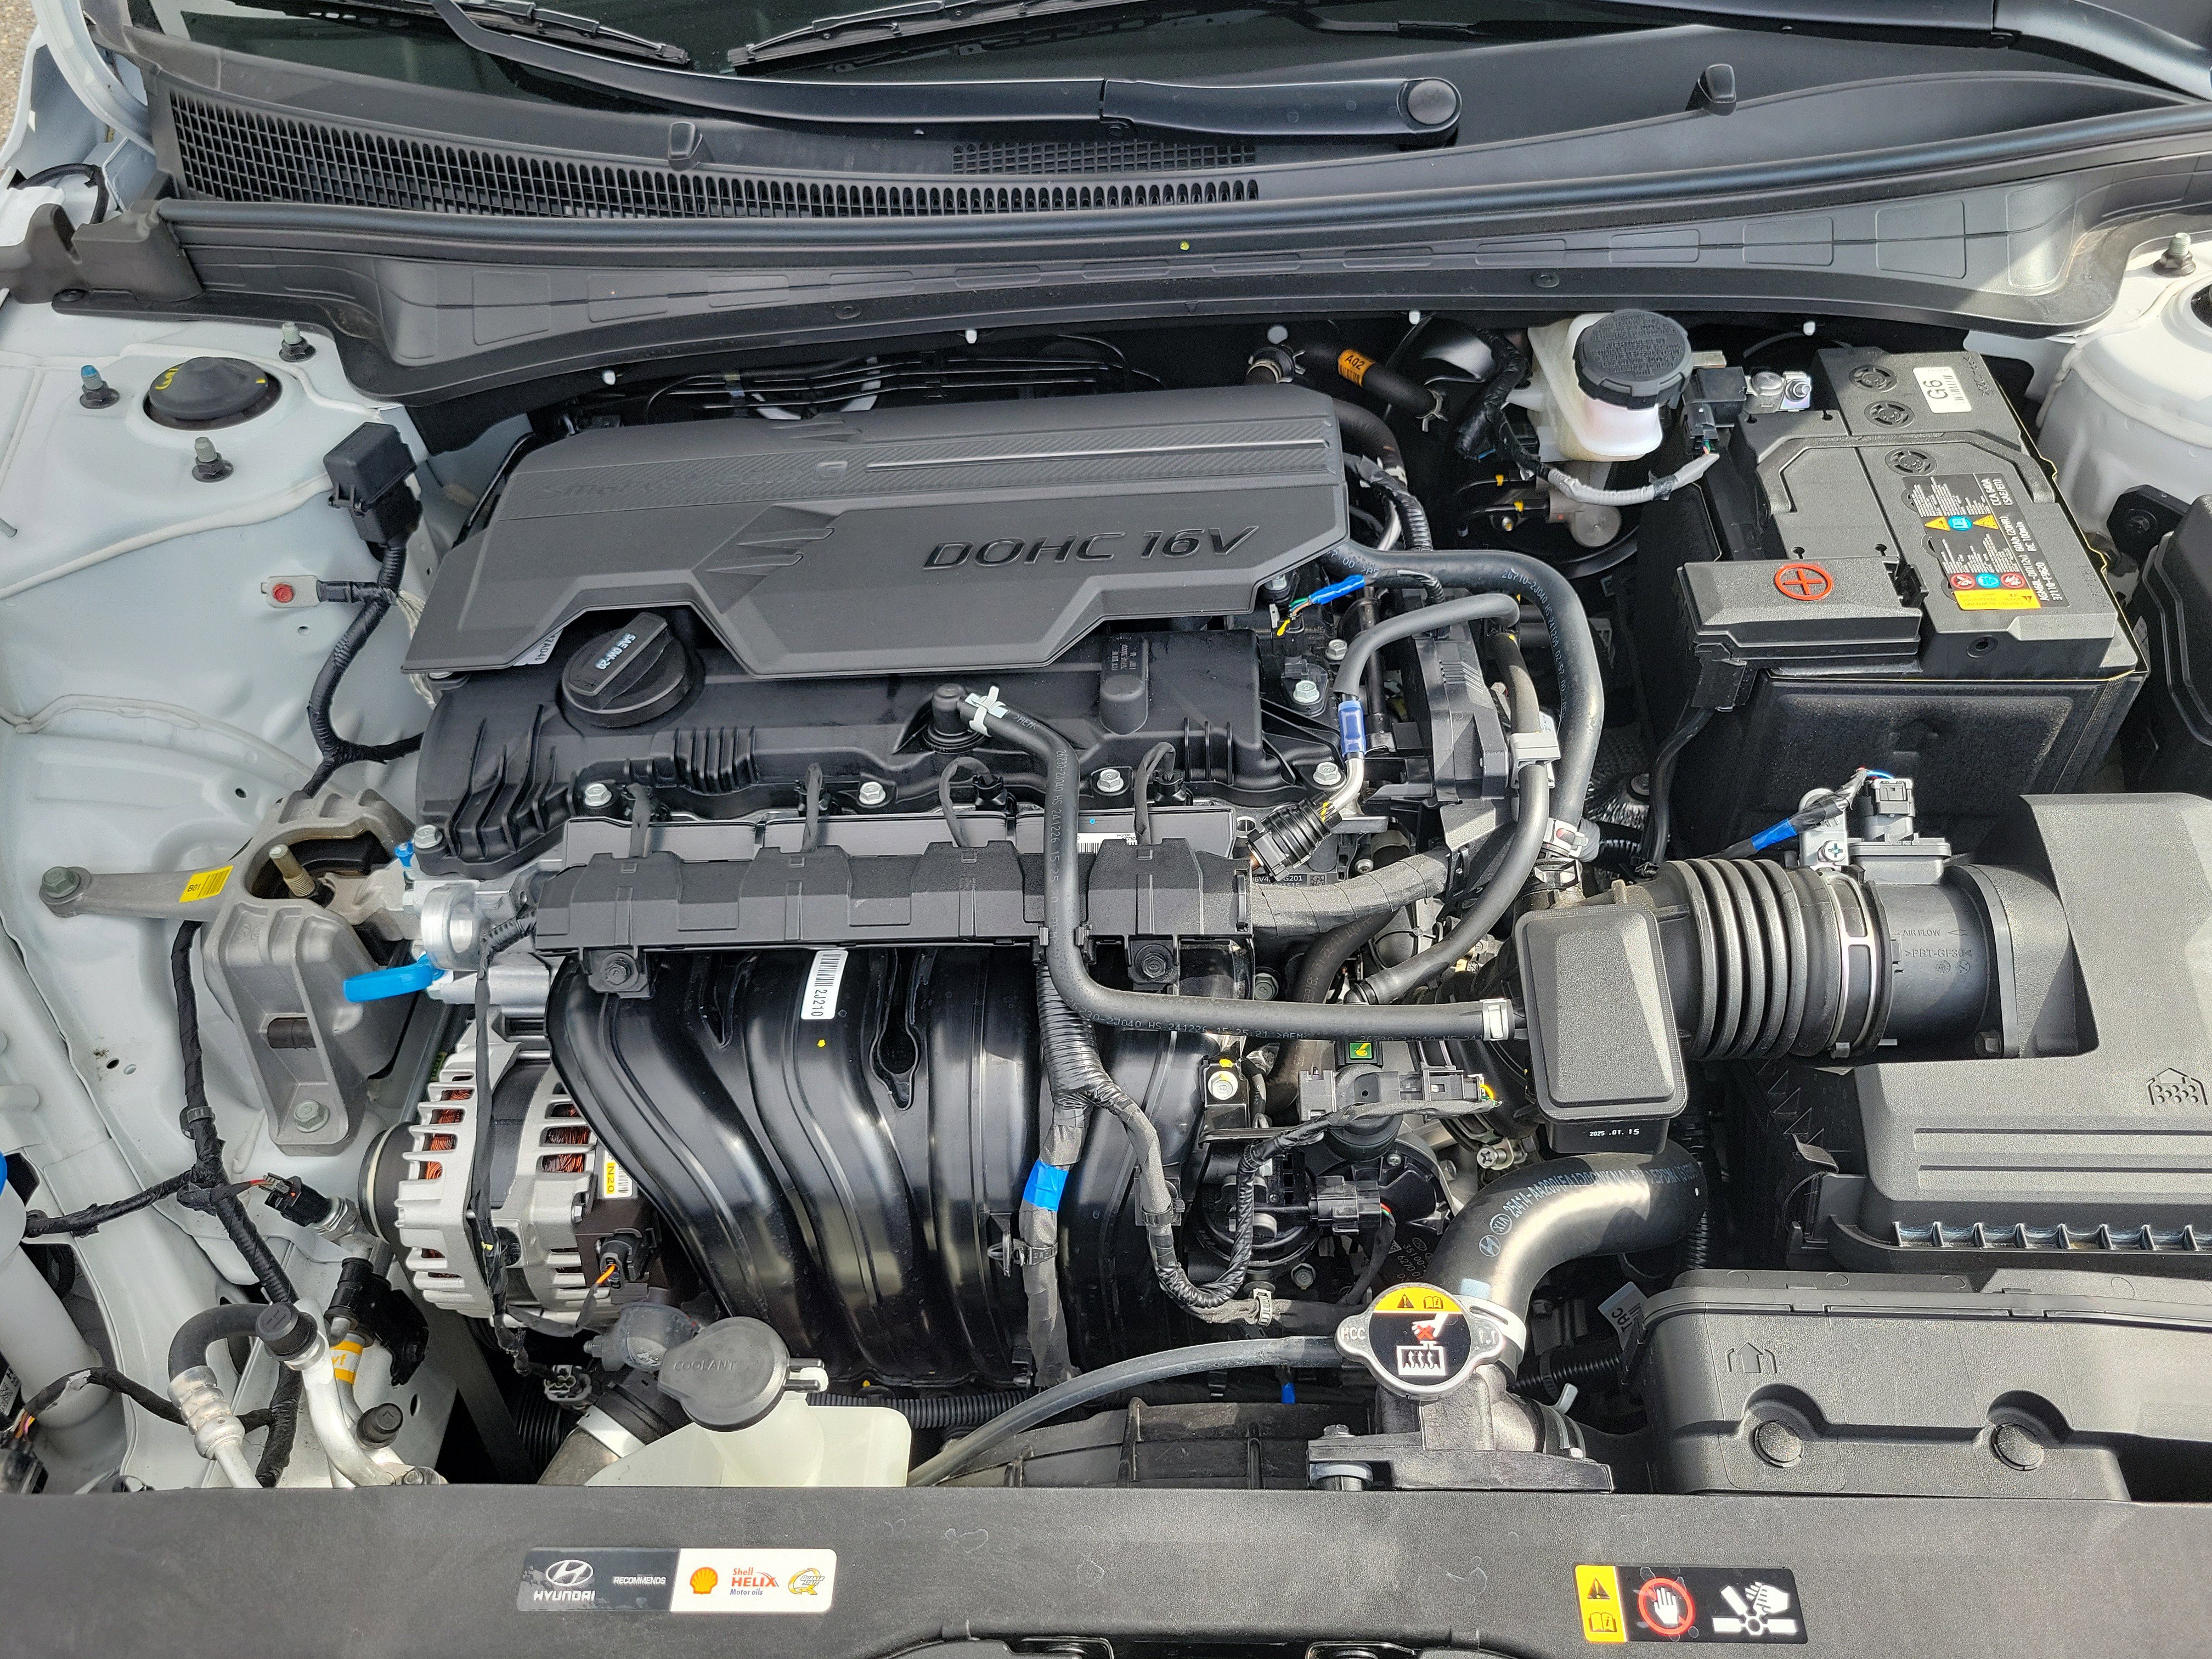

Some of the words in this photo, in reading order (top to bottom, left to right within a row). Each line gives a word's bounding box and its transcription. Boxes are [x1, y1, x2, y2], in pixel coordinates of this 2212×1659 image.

[1344, 354, 1365, 370] A02
[1922, 380, 1949, 399] G6
[923, 532, 1126, 569] DOHC
[1141, 526, 1260, 560] 16V
[2010, 535, 2025, 552] 60Ah
[2025, 541, 2037, 552] RC
[1544, 603, 1553, 617] HS
[1547, 617, 1559, 648] 241209
[617, 633, 637, 650] SAE
[595, 646, 623, 670] 0W-20
[1052, 795, 1063, 806] HS
[1050, 809, 1062, 843] 241226
[187, 883, 201, 893] B01
[811, 989, 828, 1017] 2J210
[1403, 1244, 1427, 1272] 35100-
[1611, 1307, 1633, 1333] TAC
[1340, 1327, 1366, 1341] HCC
[674, 1359, 737, 1371] COOLANT
[732, 1566, 754, 1576] Shell
[613, 1576, 667, 1585] RECOMMENDS
[731, 1577, 777, 1587] HELIX
[533, 1590, 596, 1601] HYUNDAI
